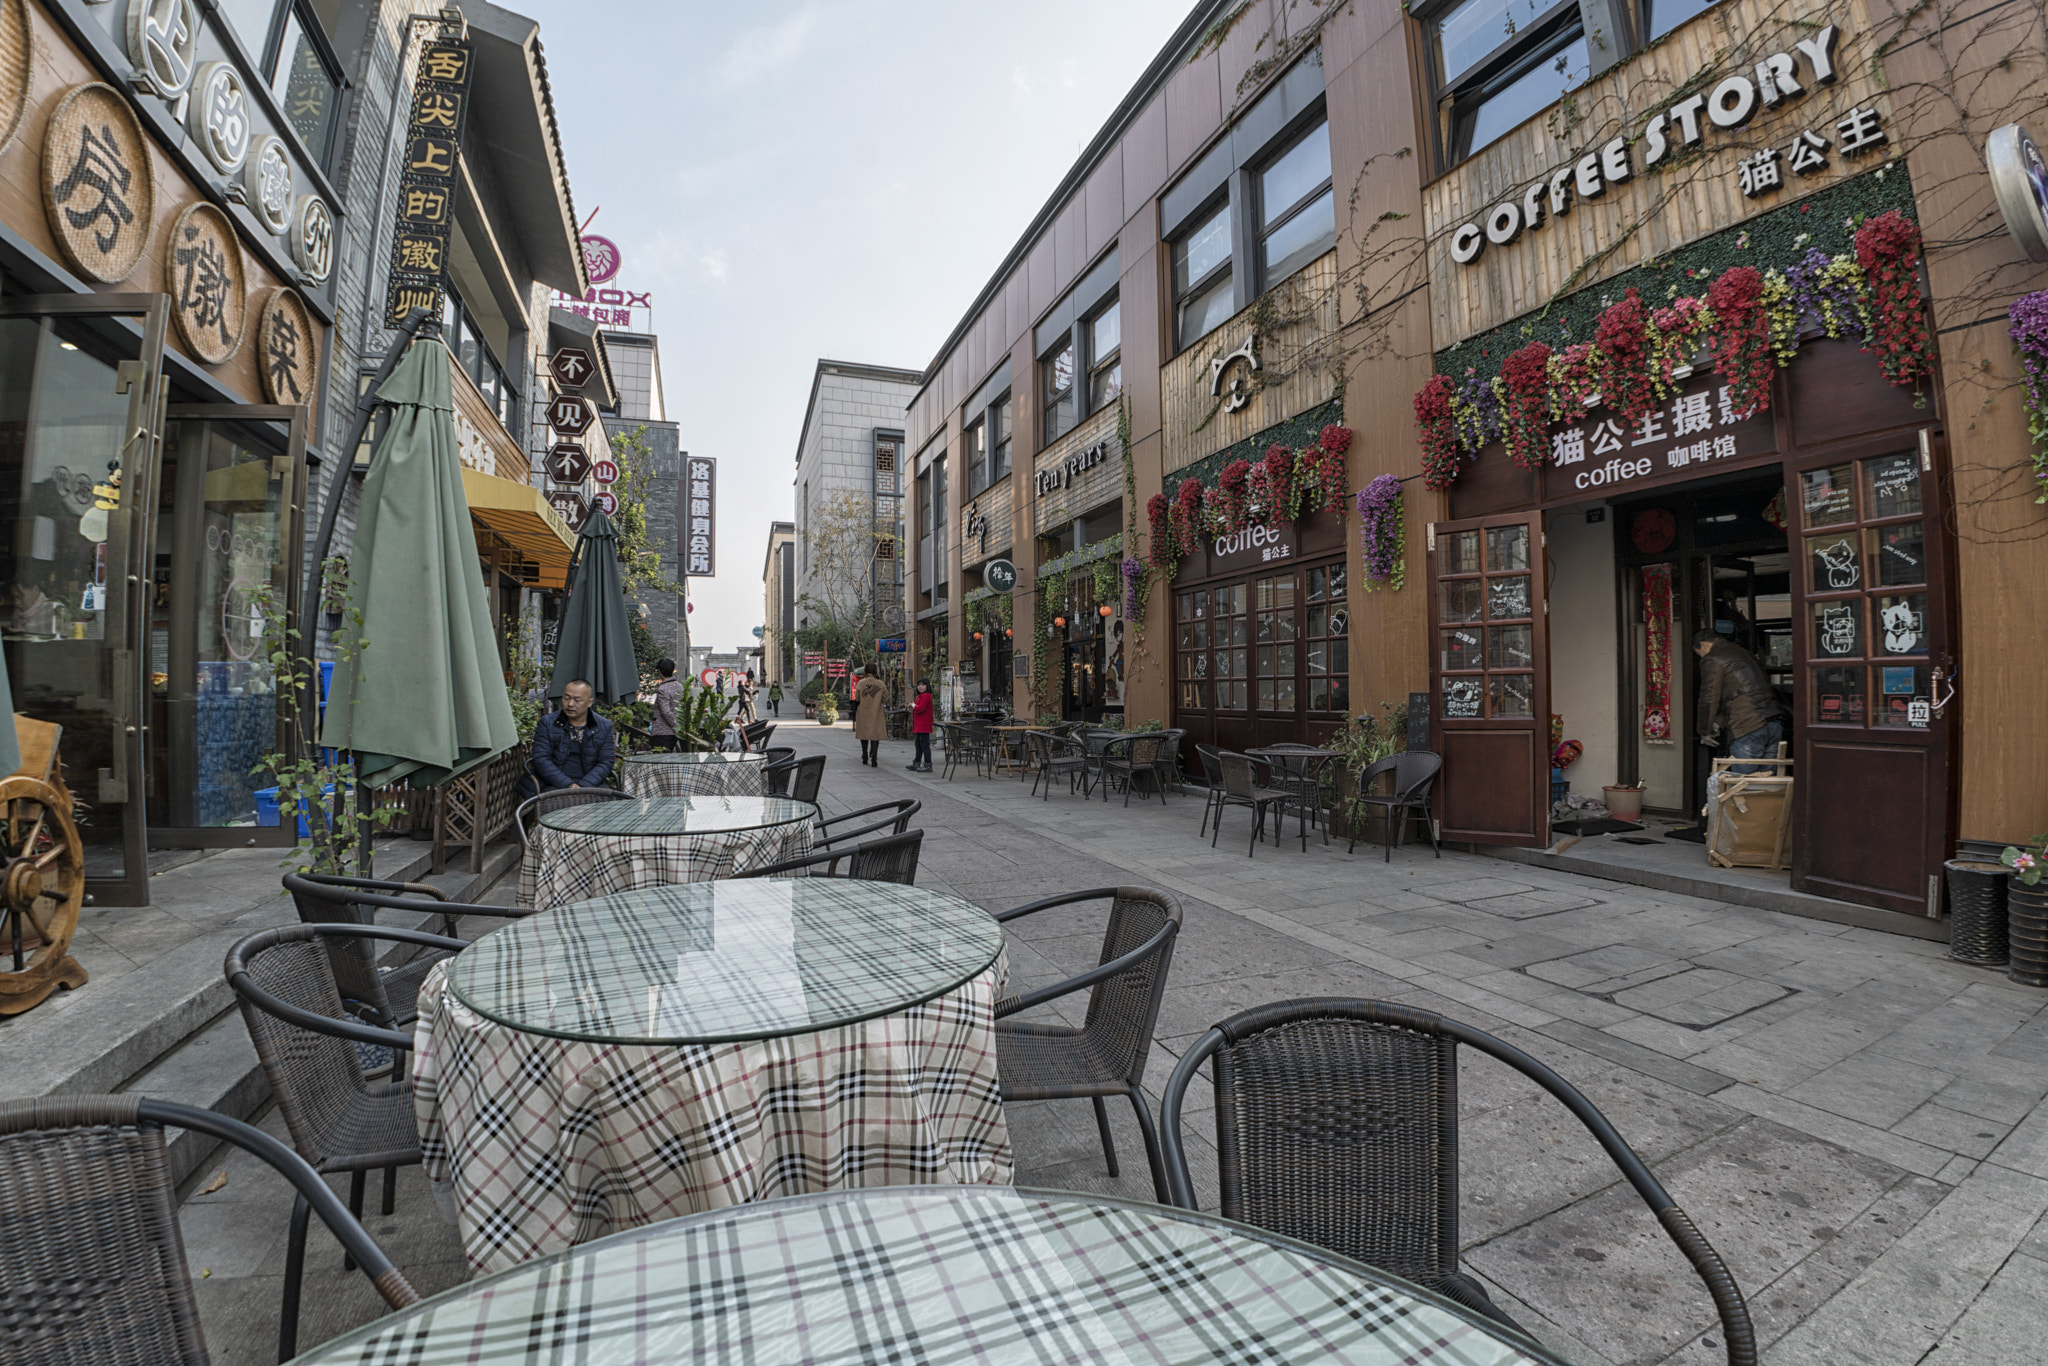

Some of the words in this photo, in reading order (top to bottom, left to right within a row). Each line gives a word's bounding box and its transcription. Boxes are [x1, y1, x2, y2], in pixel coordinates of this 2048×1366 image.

[1451, 136, 1632, 265] COFFEE
[1645, 24, 1838, 167] STORY
[1738, 106, 1888, 198] 猫公主
[554, 355, 585, 525] 不见不散
[1667, 434, 1737, 468] 咖啡馆
[1035, 471, 1059, 497] Ten
[1063, 442, 1105, 489] years
[1575, 457, 1652, 489] coffee
[689, 462, 710, 572] 洛基健身会所
[1216, 521, 1280, 557] coffee
[1262, 544, 1290, 562] 猫公主
[886, 641, 905, 651] Tiger
[1911, 704, 1927, 719] 拉
